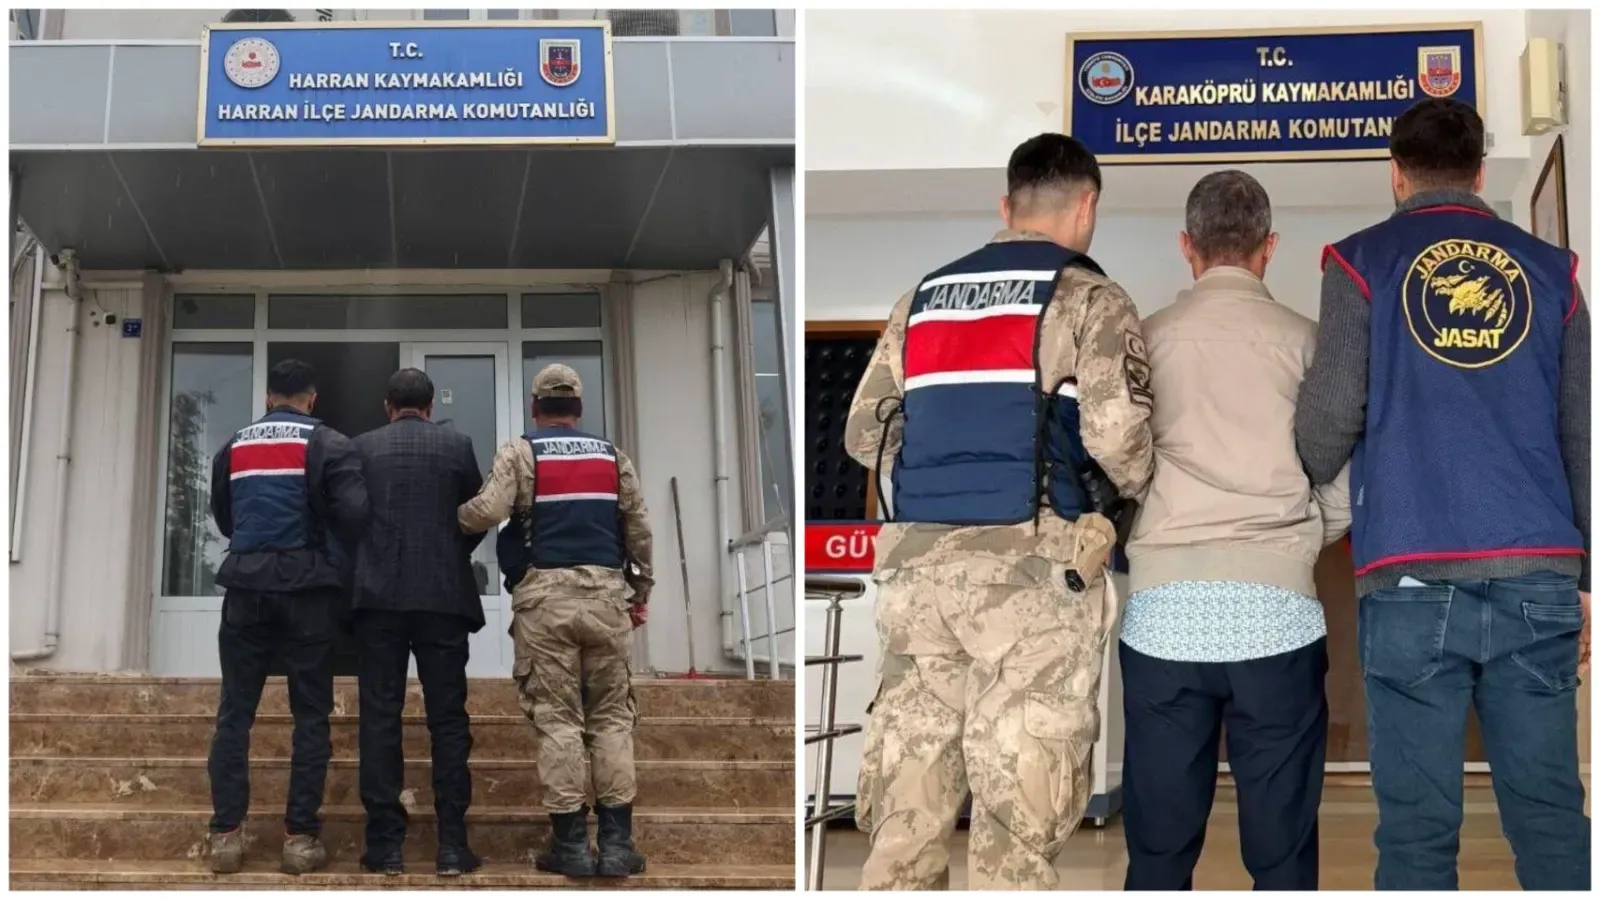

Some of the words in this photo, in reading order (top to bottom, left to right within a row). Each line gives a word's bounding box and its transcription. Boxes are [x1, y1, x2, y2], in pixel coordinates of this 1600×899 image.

[390, 42, 423, 58] T.C.
[1256, 47, 1294, 66] T.C.
[289, 73, 369, 89] HARRAN
[374, 67, 523, 88] KAYMAKAMLIĞI
[1135, 79, 1256, 106] KARAKÖPRÜ
[1262, 74, 1414, 103] KAYMAKAMLIĞI
[218, 104, 298, 120] HARRAN
[304, 100, 346, 123] İLÇE
[351, 103, 458, 119] JANDARMA
[463, 98, 595, 118] KOMUTANLIĞI
[1115, 118, 1162, 147] İLÇE
[1168, 119, 1281, 141] JANDARMA
[1288, 116, 1397, 139] KOMUTAN
[1415, 243, 1520, 283] JANDARMA
[923, 279, 1035, 311] JANDARMA
[1433, 327, 1505, 350] JASAT
[542, 440, 608, 454] JANDARMA
